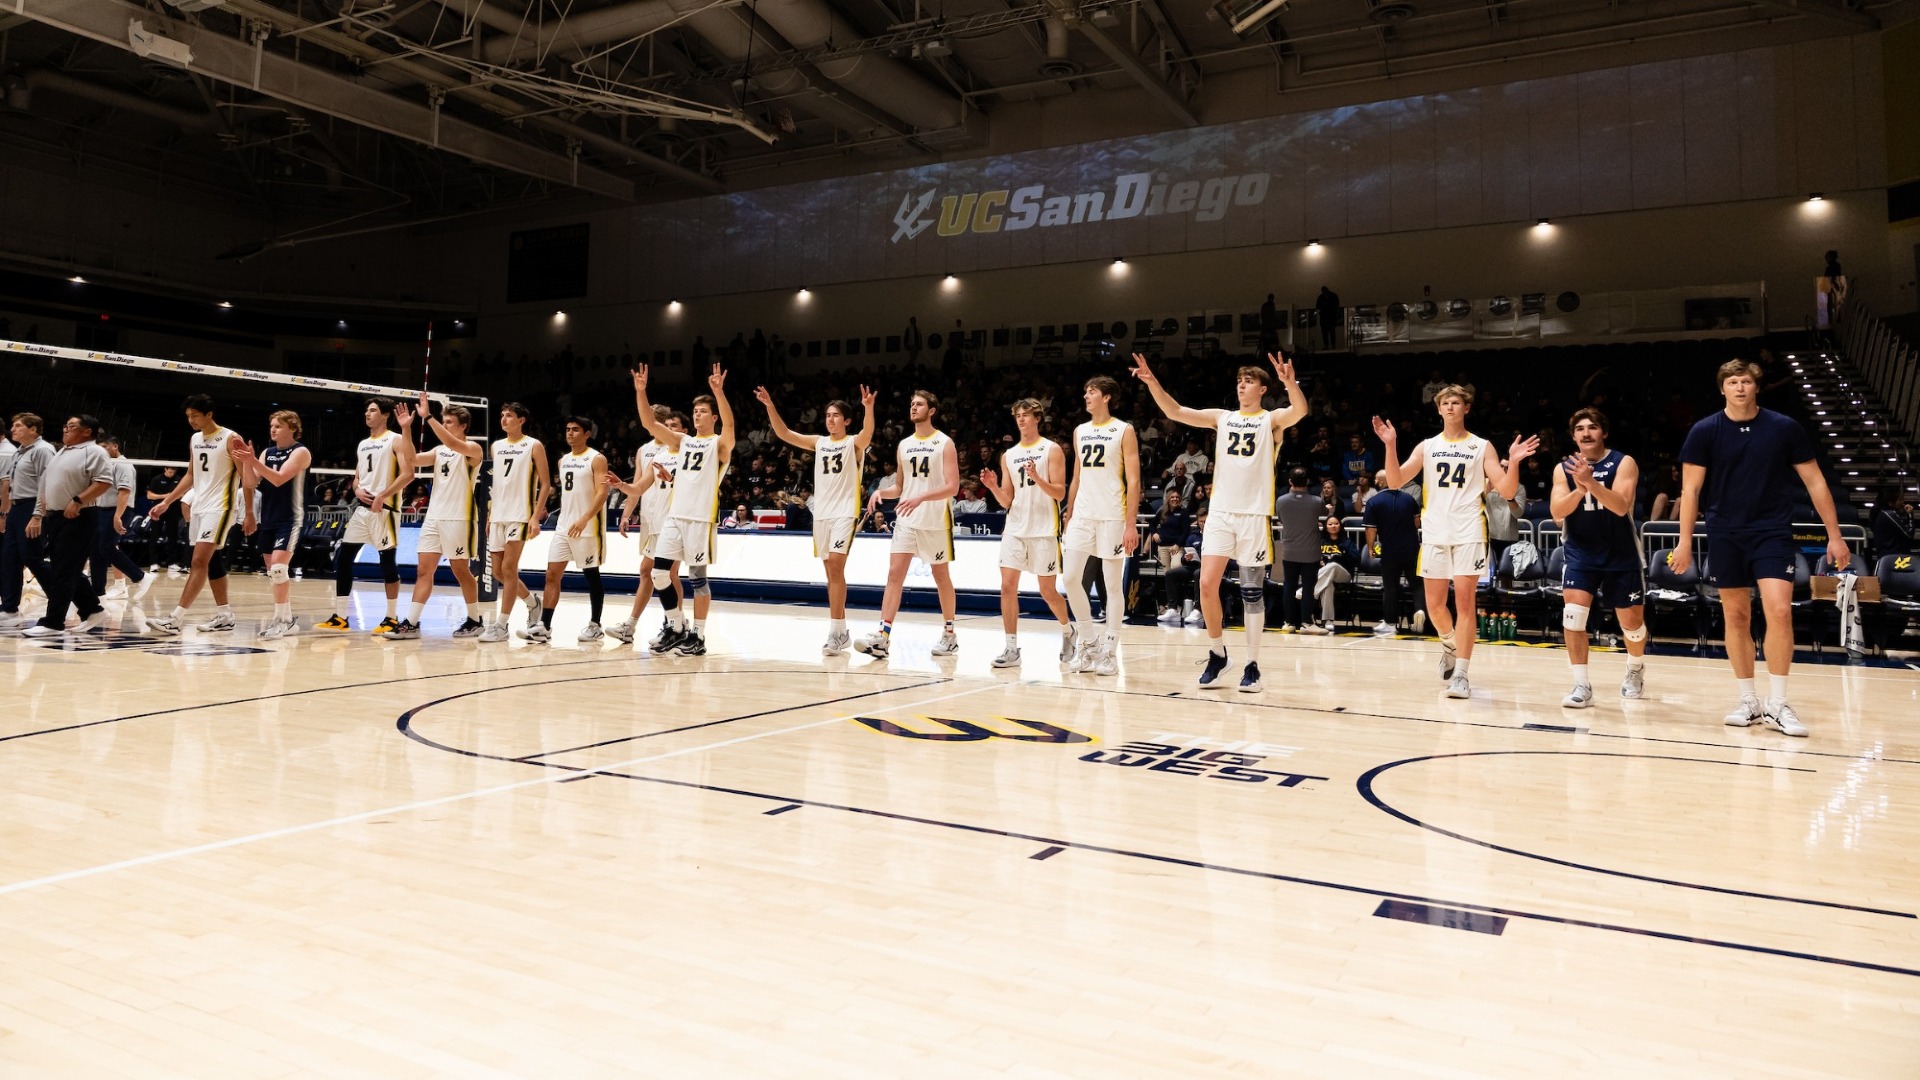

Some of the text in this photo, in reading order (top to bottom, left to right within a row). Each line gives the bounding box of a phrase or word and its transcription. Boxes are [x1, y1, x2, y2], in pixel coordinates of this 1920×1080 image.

[1227, 432, 1256, 456] 23
[199, 452, 209, 472] 2
[366, 453, 374, 473] 1
[682, 451, 704, 471] 12
[822, 453, 843, 475] 13
[1082, 444, 1105, 467] 22
[1431, 451, 1475, 460] UCSanDiego
[440, 460, 450, 477] 4
[503, 458, 514, 477] 7
[909, 456, 930, 478] 14
[1436, 462, 1466, 489] 24
[564, 471, 574, 491] 8
[1105, 741, 1268, 767] BIG
[1144, 731, 1305, 758] THE
[1078, 750, 1330, 788] WEST
